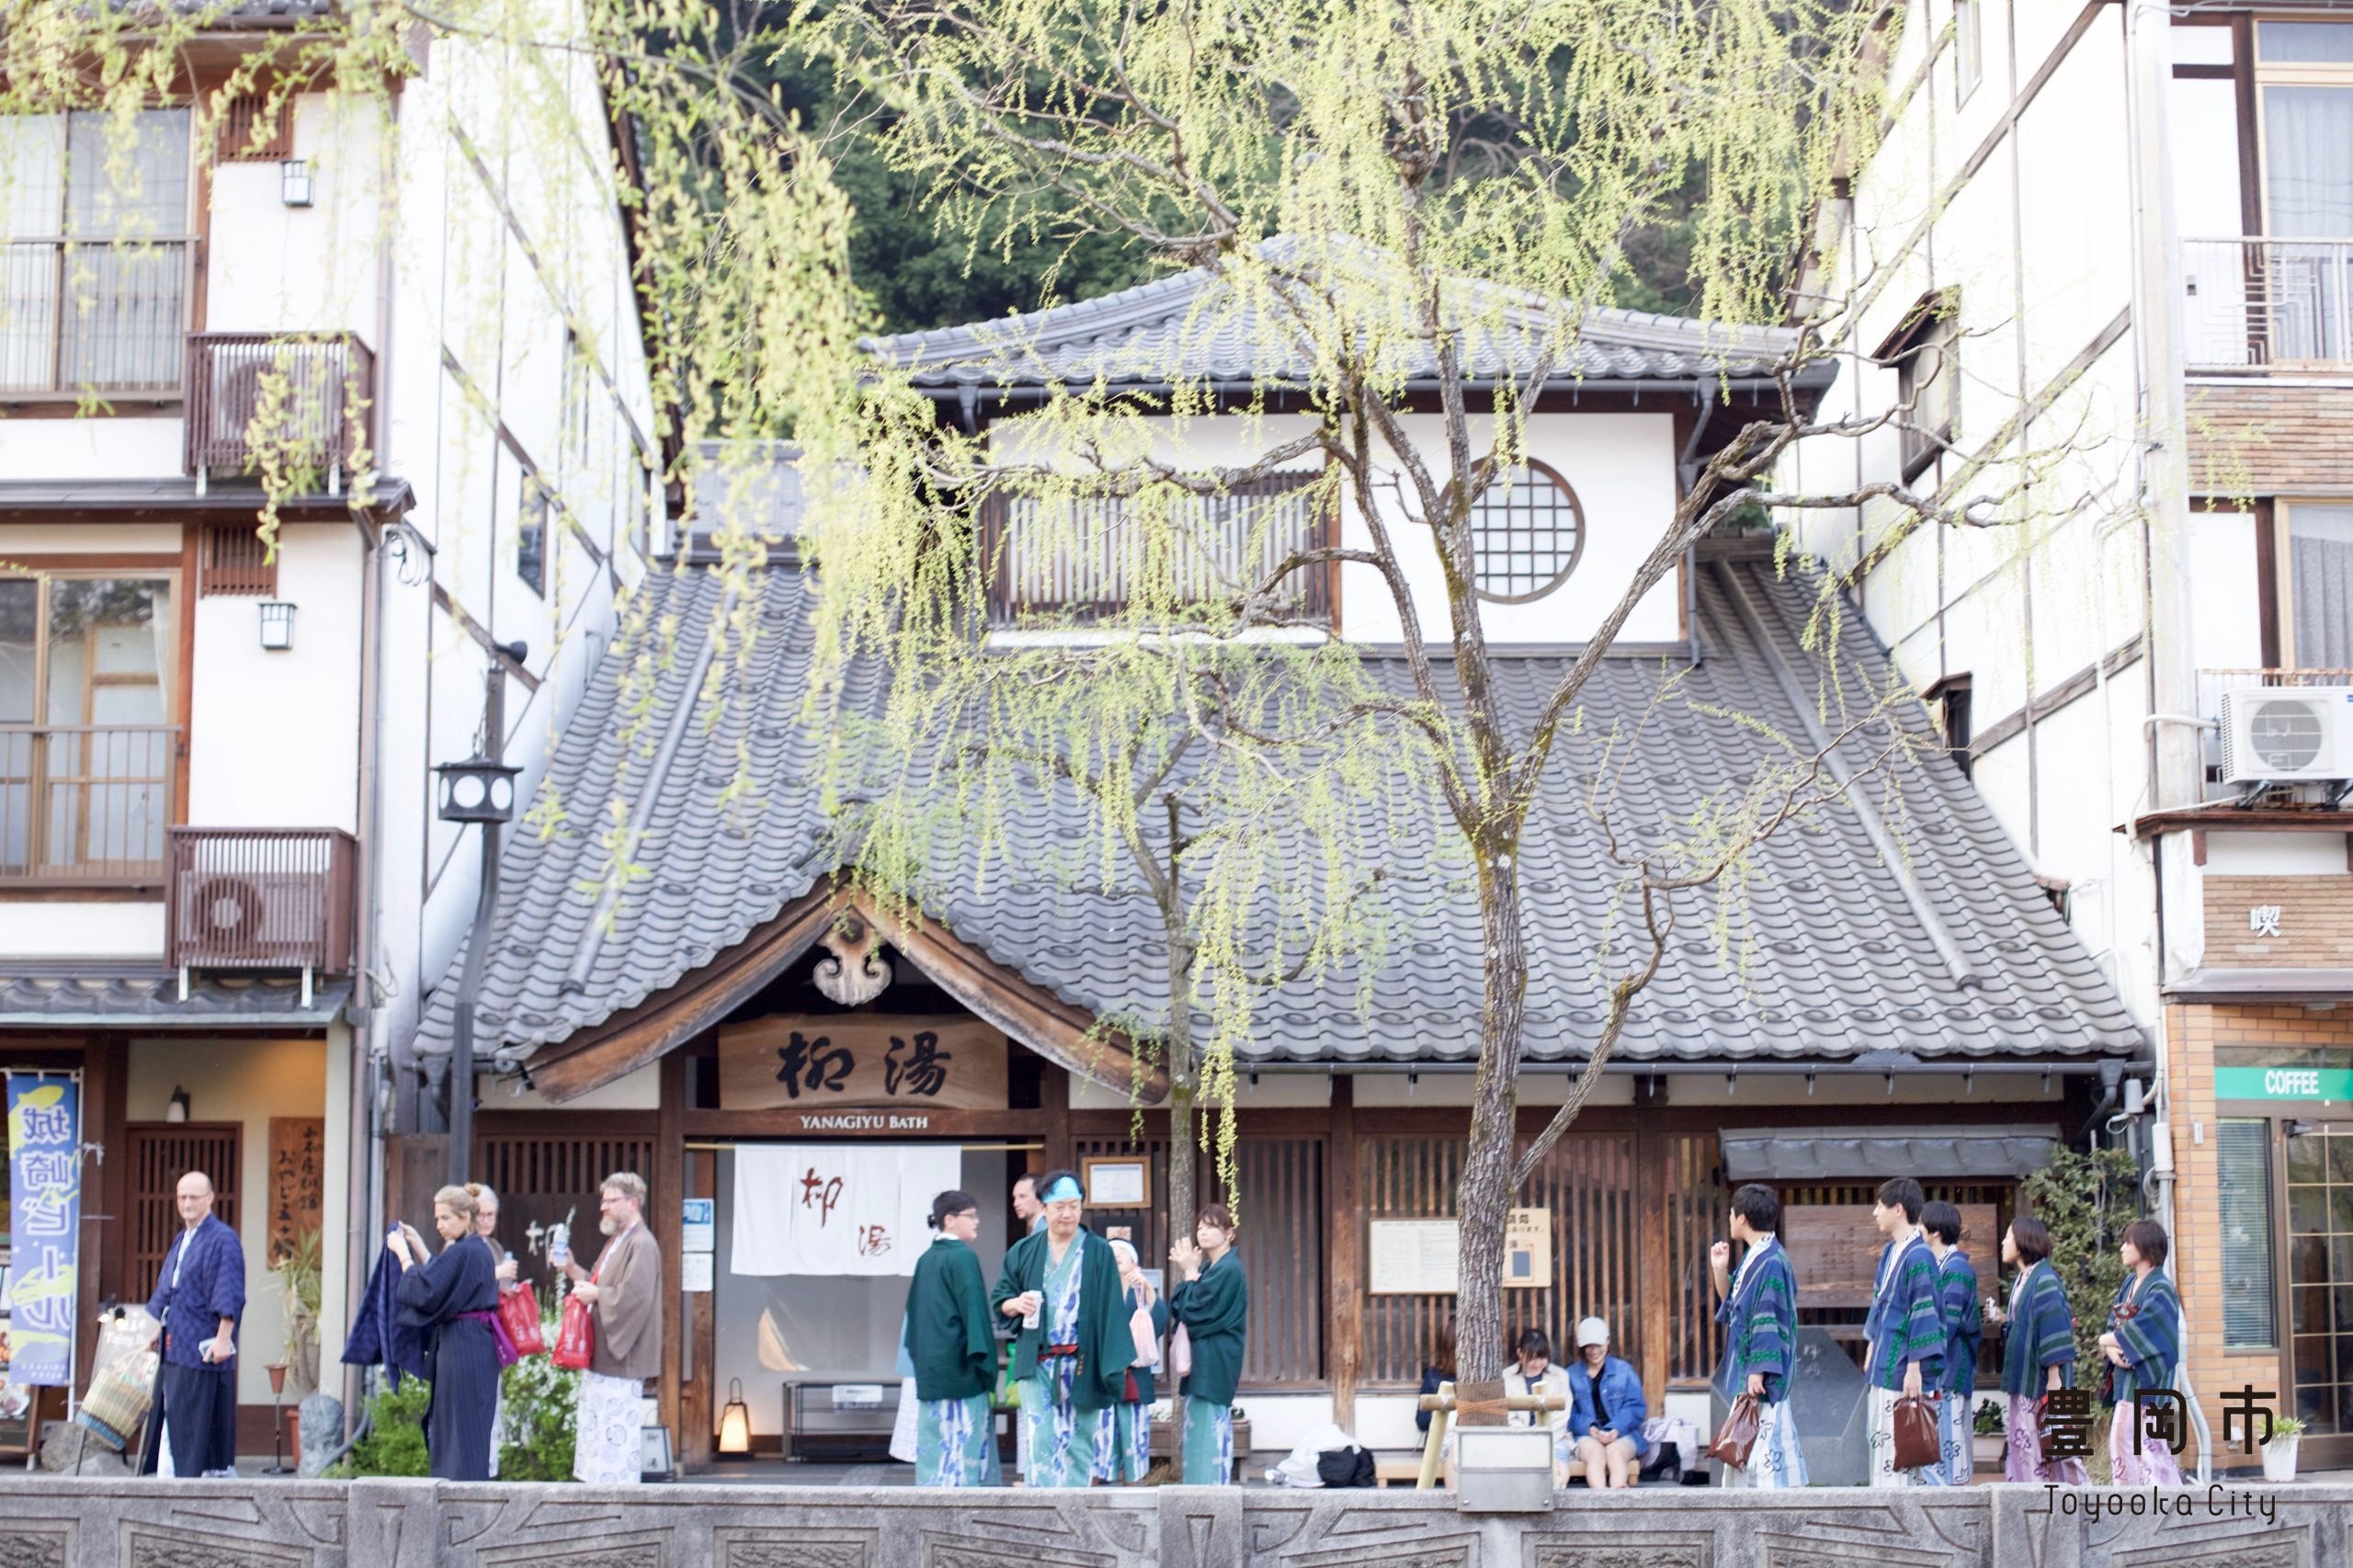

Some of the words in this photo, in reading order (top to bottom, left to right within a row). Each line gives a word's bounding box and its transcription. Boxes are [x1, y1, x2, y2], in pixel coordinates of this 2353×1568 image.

[2250, 904, 2282, 937] 喫
[776, 1031, 951, 1099] 柳湯
[2265, 1070, 2320, 1095] COFFEE
[801, 1115, 884, 1130] YANAGIYU
[889, 1115, 928, 1129] BATH
